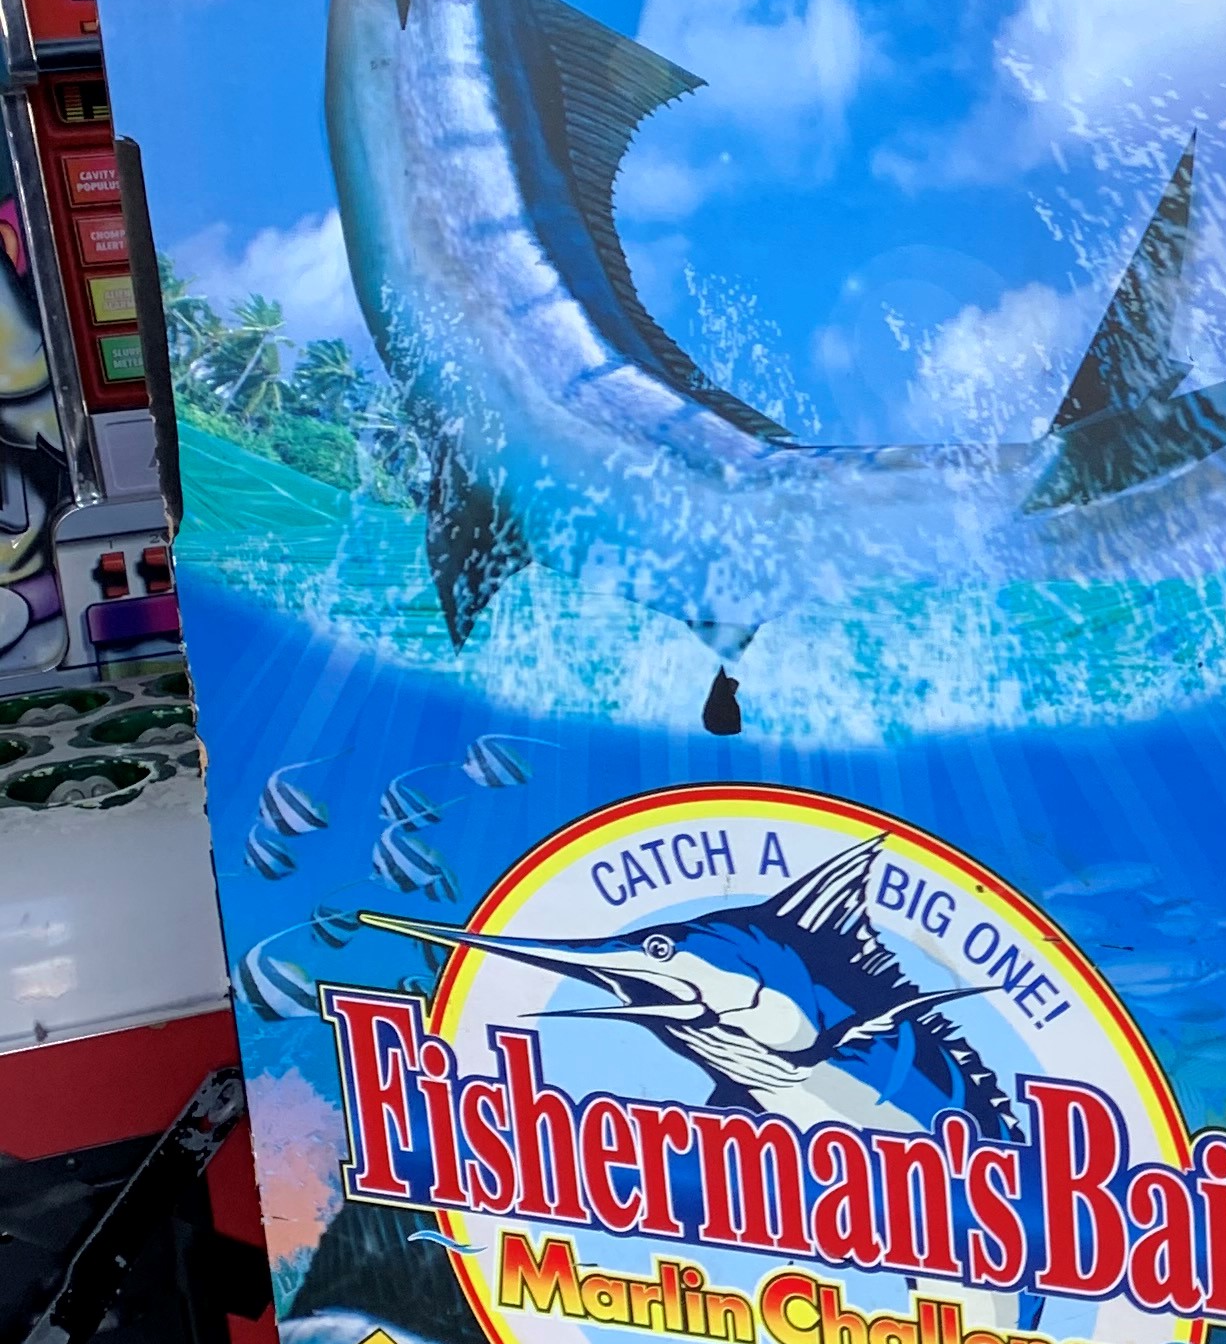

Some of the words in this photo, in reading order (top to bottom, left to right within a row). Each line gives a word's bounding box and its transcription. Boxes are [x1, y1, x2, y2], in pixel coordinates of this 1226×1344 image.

[79, 168, 116, 182] CAVITY
[89, 230, 126, 242] CHOMP
[95, 240, 125, 252] ALERT
[149, 533, 160, 544] 2
[591, 829, 735, 907] CATCH
[758, 831, 791, 878] A
[875, 862, 958, 939] BIG
[963, 921, 1073, 1031] ONE!
[332, 994, 1028, 1289] Fisherman's
